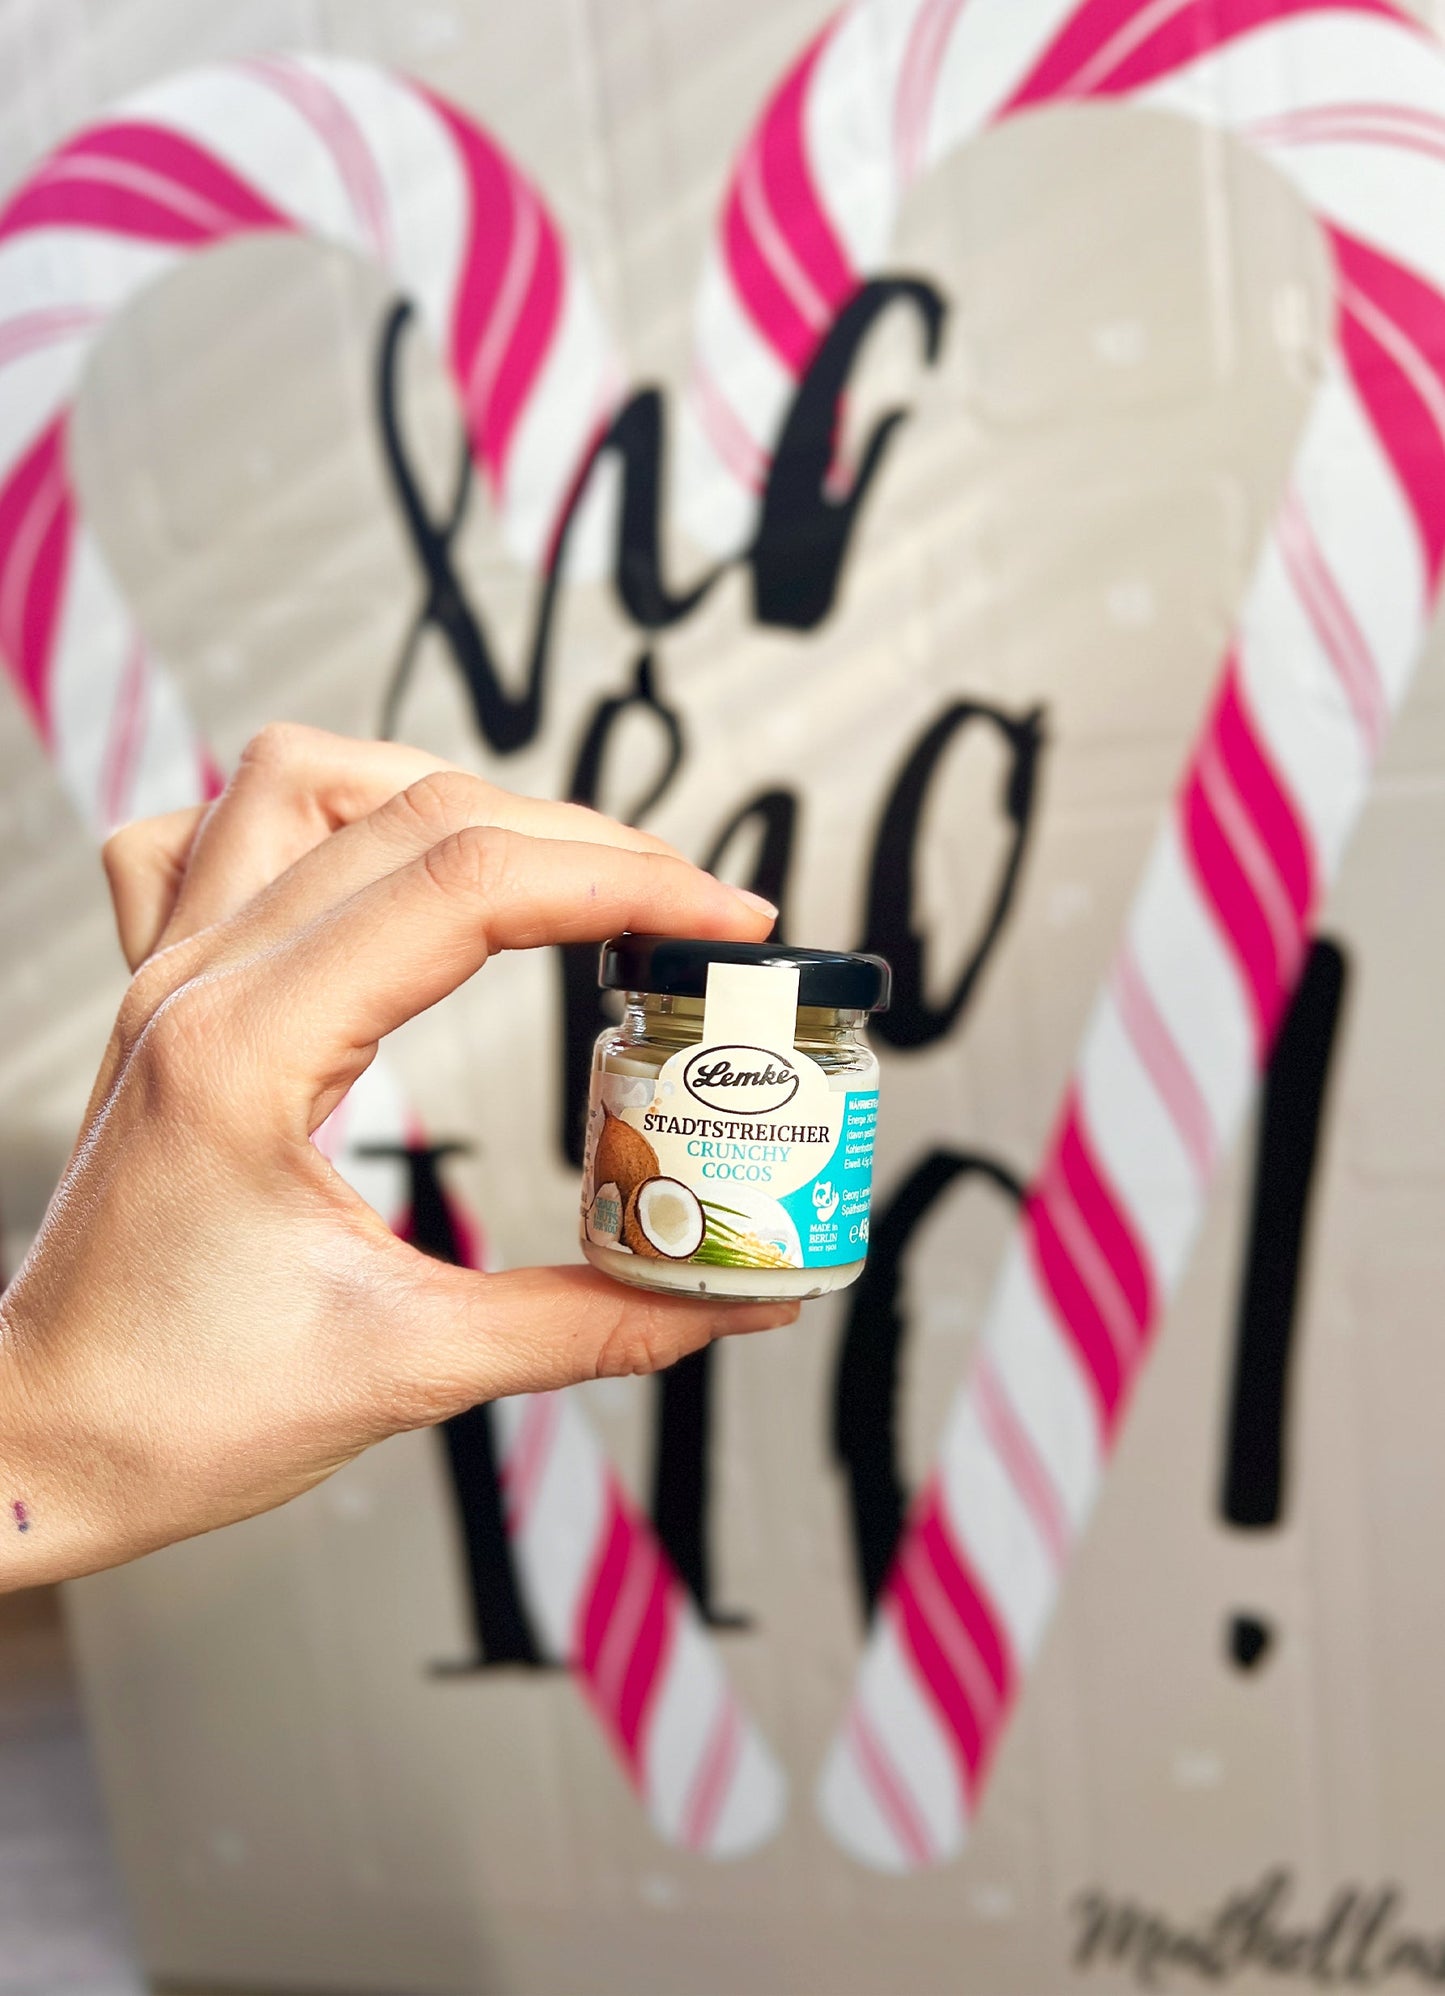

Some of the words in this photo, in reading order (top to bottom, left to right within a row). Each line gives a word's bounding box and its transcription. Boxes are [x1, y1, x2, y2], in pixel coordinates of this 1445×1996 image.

[692, 1060, 791, 1088] Lemke
[643, 1114, 830, 1144] STADTSTREICHER
[686, 1139, 792, 1163] CRUNCHY
[701, 1162, 773, 1183] COCOS
[809, 1233, 838, 1244] BERLIN
[810, 1223, 831, 1233] MADE
